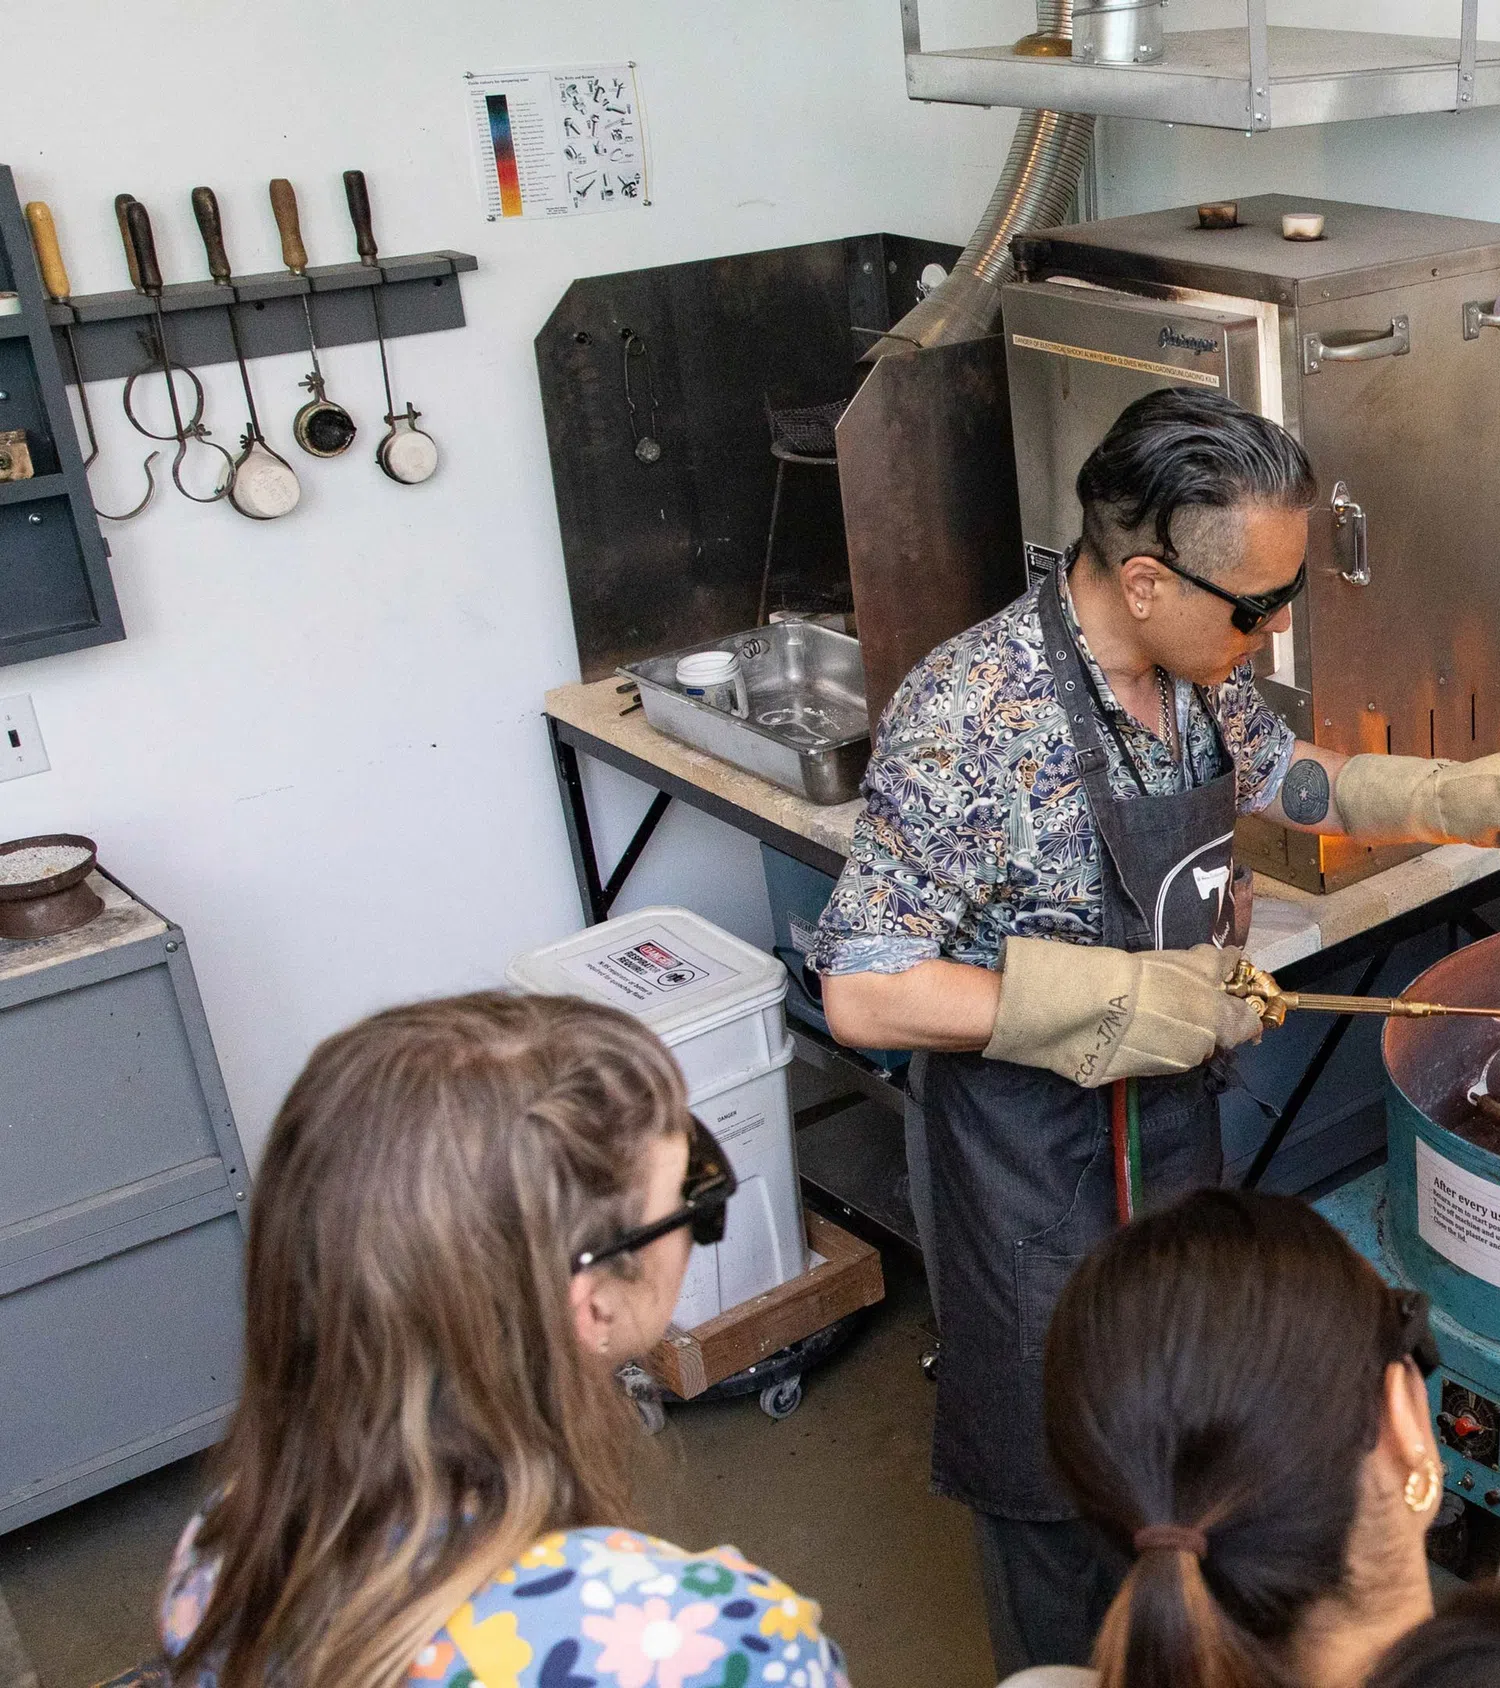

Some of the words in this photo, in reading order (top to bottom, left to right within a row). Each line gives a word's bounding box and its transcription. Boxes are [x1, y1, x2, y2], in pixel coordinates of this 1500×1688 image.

[1040, 342, 1067, 354] ELECTRICAL
[1084, 350, 1104, 360] ALWAYS
[1104, 354, 1118, 363] WEAR
[1118, 357, 1137, 367] GLOVES
[1137, 360, 1153, 370] WHEN
[1205, 376, 1218, 384] KILN
[616, 956, 648, 975] REQUIRED
[624, 950, 662, 974] RESPIRATOR
[717, 1110, 738, 1123] DANGER
[1433, 1177, 1457, 1198] After
[1458, 1194, 1488, 1217] every
[1433, 1188, 1451, 1207] Return
[1451, 1202, 1464, 1213] arm
[1465, 1210, 1471, 1218] to
[1472, 1214, 1488, 1226] start
[1433, 1197, 1446, 1212] Turn
[1446, 1209, 1455, 1217] off
[1455, 1213, 1480, 1231] machine
[1481, 1227, 1495, 1239] and
[1433, 1206, 1454, 1226] Vacuum
[1455, 1222, 1465, 1233] out
[1465, 1227, 1488, 1245] plaster
[1433, 1216, 1447, 1230] Close
[1447, 1227, 1457, 1236] the
[1457, 1232, 1468, 1244] lid.
